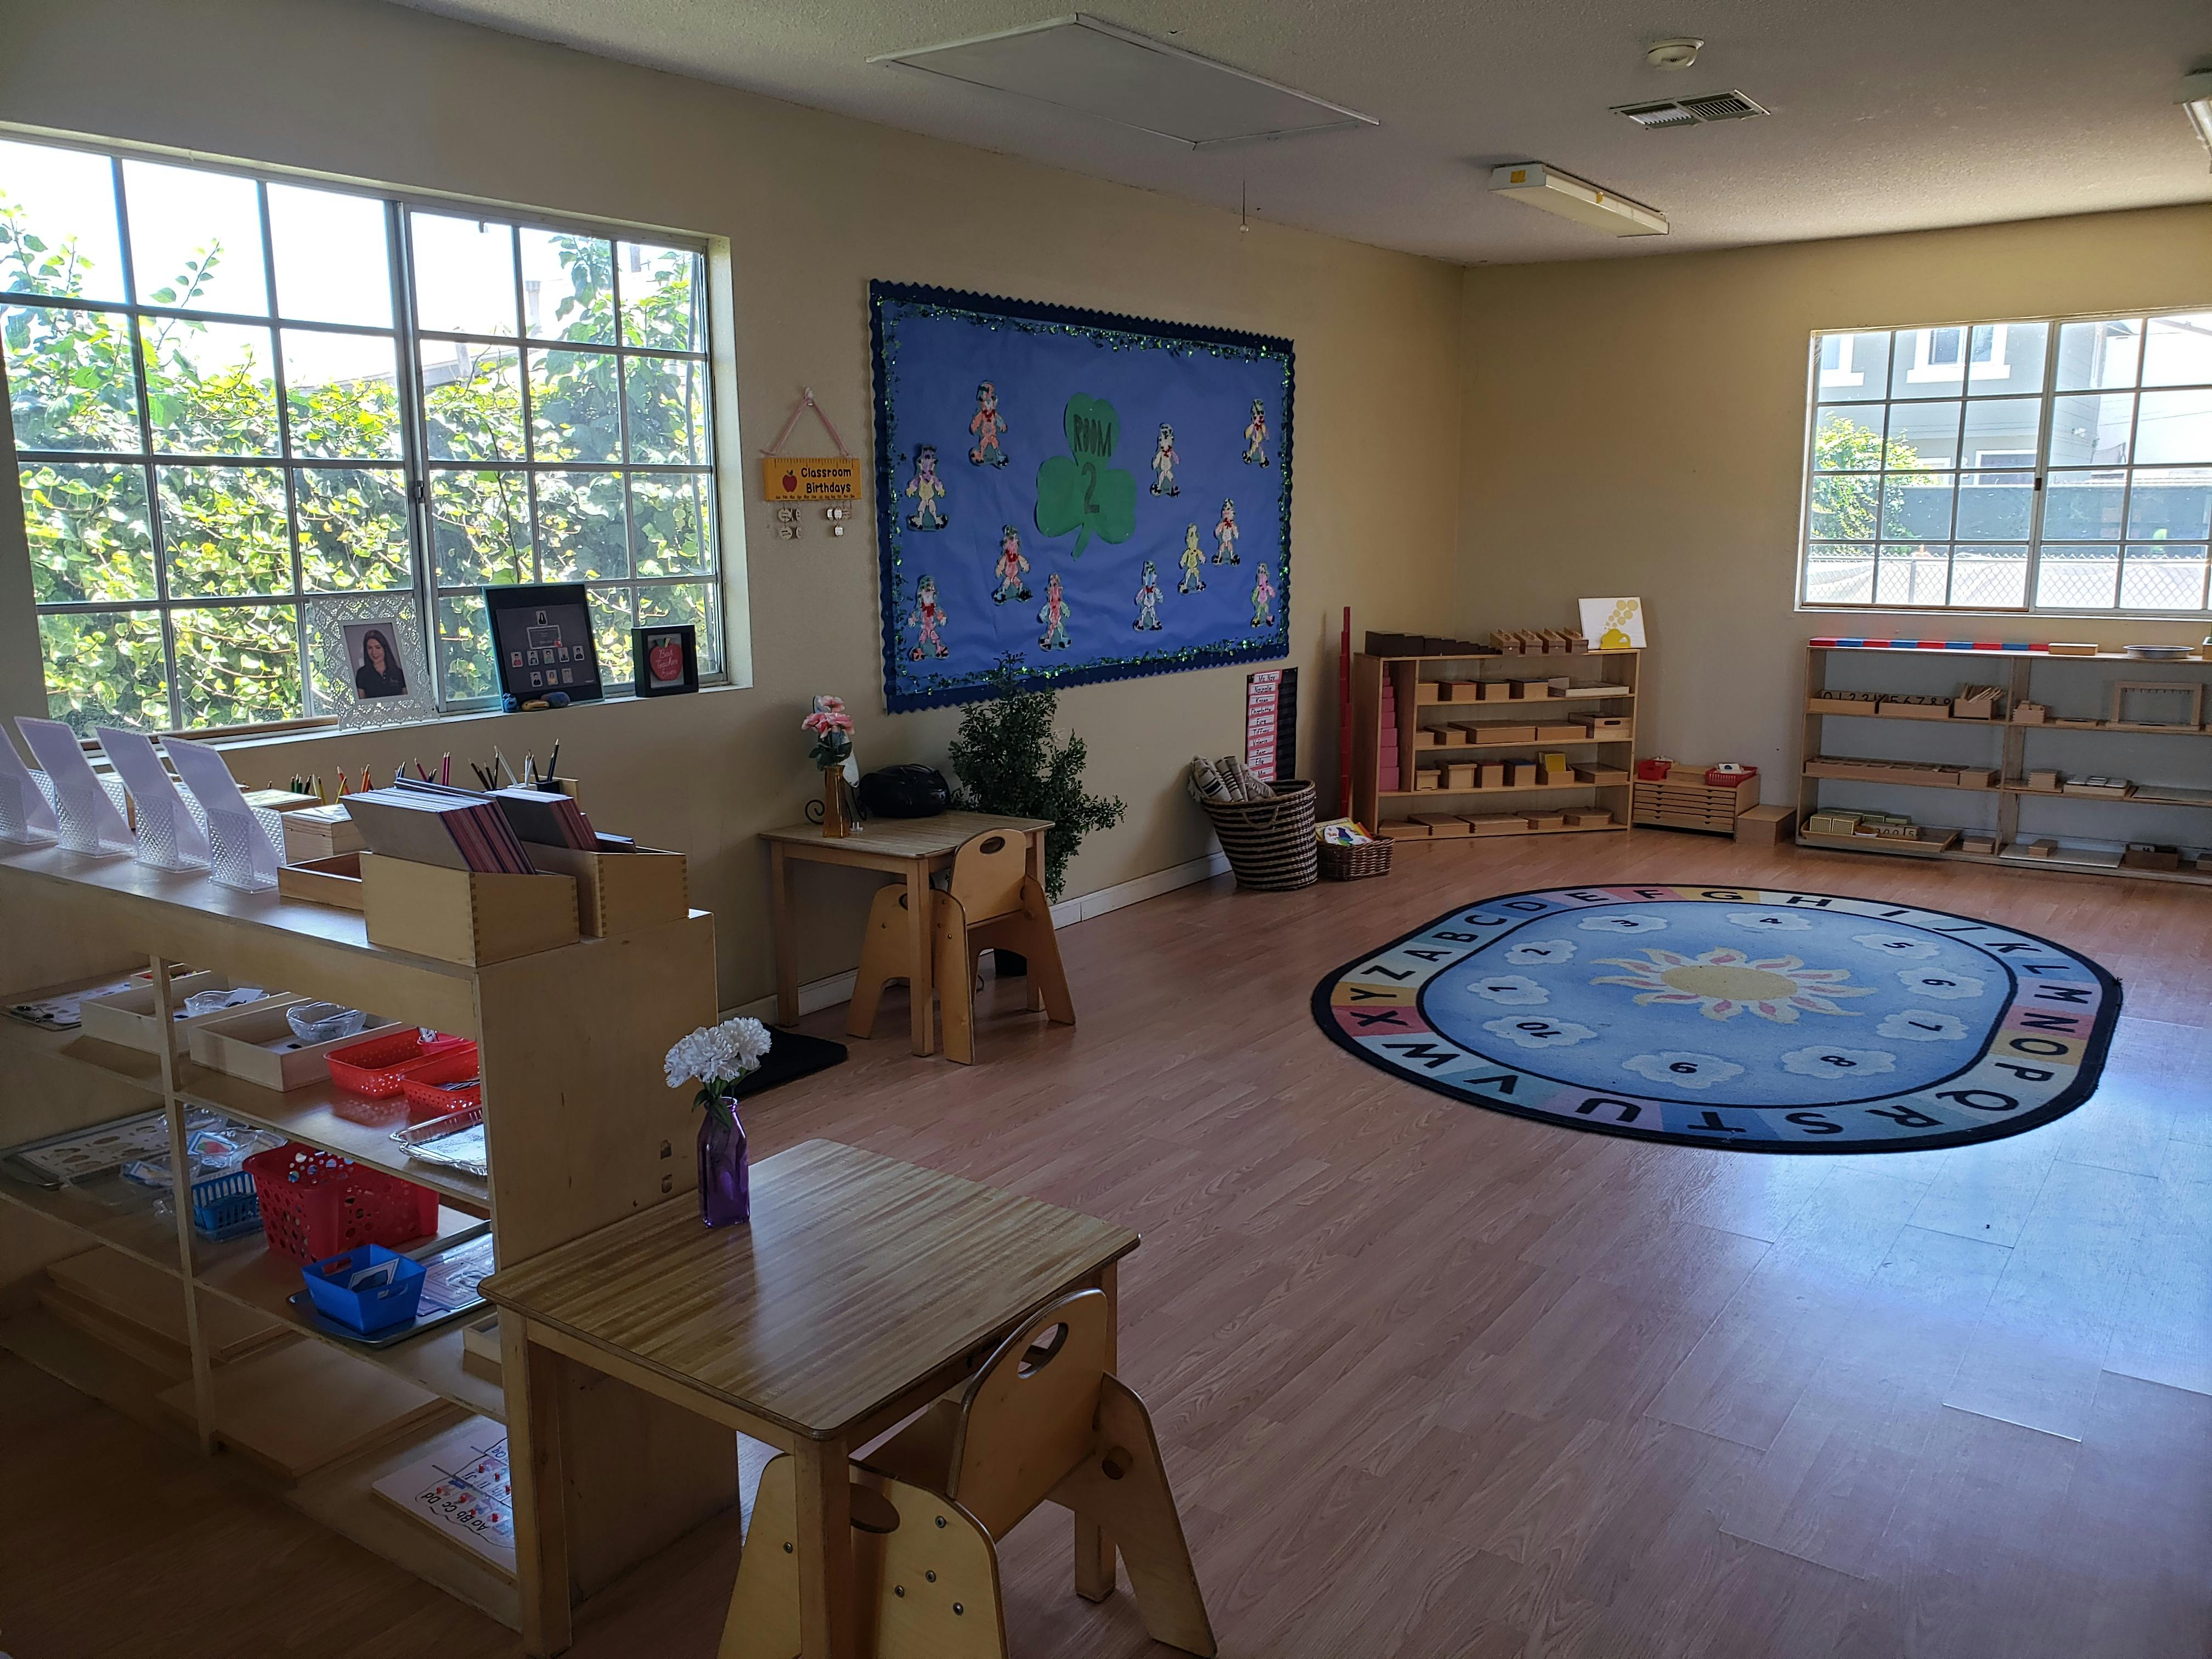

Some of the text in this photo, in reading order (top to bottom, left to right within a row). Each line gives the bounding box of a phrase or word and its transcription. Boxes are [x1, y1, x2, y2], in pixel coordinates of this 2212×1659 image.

[1073, 414, 1111, 457] ROOM
[801, 467, 851, 477] Classroom
[806, 482, 851, 494] Birthdays
[1081, 461, 1099, 514] 2
[659, 648, 673, 658] Best
[655, 657, 679, 668] Teacher
[1565, 891, 1610, 902] E
[1633, 889, 1664, 899] F
[1701, 891, 1744, 900] G
[1501, 901, 1548, 911] D
[1786, 896, 1833, 907] H
[1464, 915, 1508, 926] C
[1431, 932, 1479, 944] B
[1984, 943, 2042, 953] K
[1403, 950, 1452, 962] A
[1361, 964, 1416, 981] Z
[2022, 964, 2070, 974] L
[1350, 987, 1397, 1001] Y
[2034, 985, 2092, 1005] M
[1350, 1010, 1409, 1027] X
[2020, 1012, 2079, 1033] N
[1516, 1022, 1562, 1039] 10
[1908, 1020, 1943, 1032] 7
[2009, 1038, 2069, 1056] O
[1381, 1043, 1460, 1069] W
[1820, 1055, 1858, 1067] 8
[1669, 1062, 1699, 1074] 9
[1995, 1062, 2055, 1082] P
[1463, 1075, 1519, 1095] V
[1936, 1090, 2019, 1111] Q
[1575, 1098, 1642, 1123] U
[1865, 1105, 1945, 1128] R
[1687, 1111, 1747, 1136] T
[1785, 1112, 1844, 1135] S
[421, 1492, 490, 1531] Aa Bb Cc Dd
